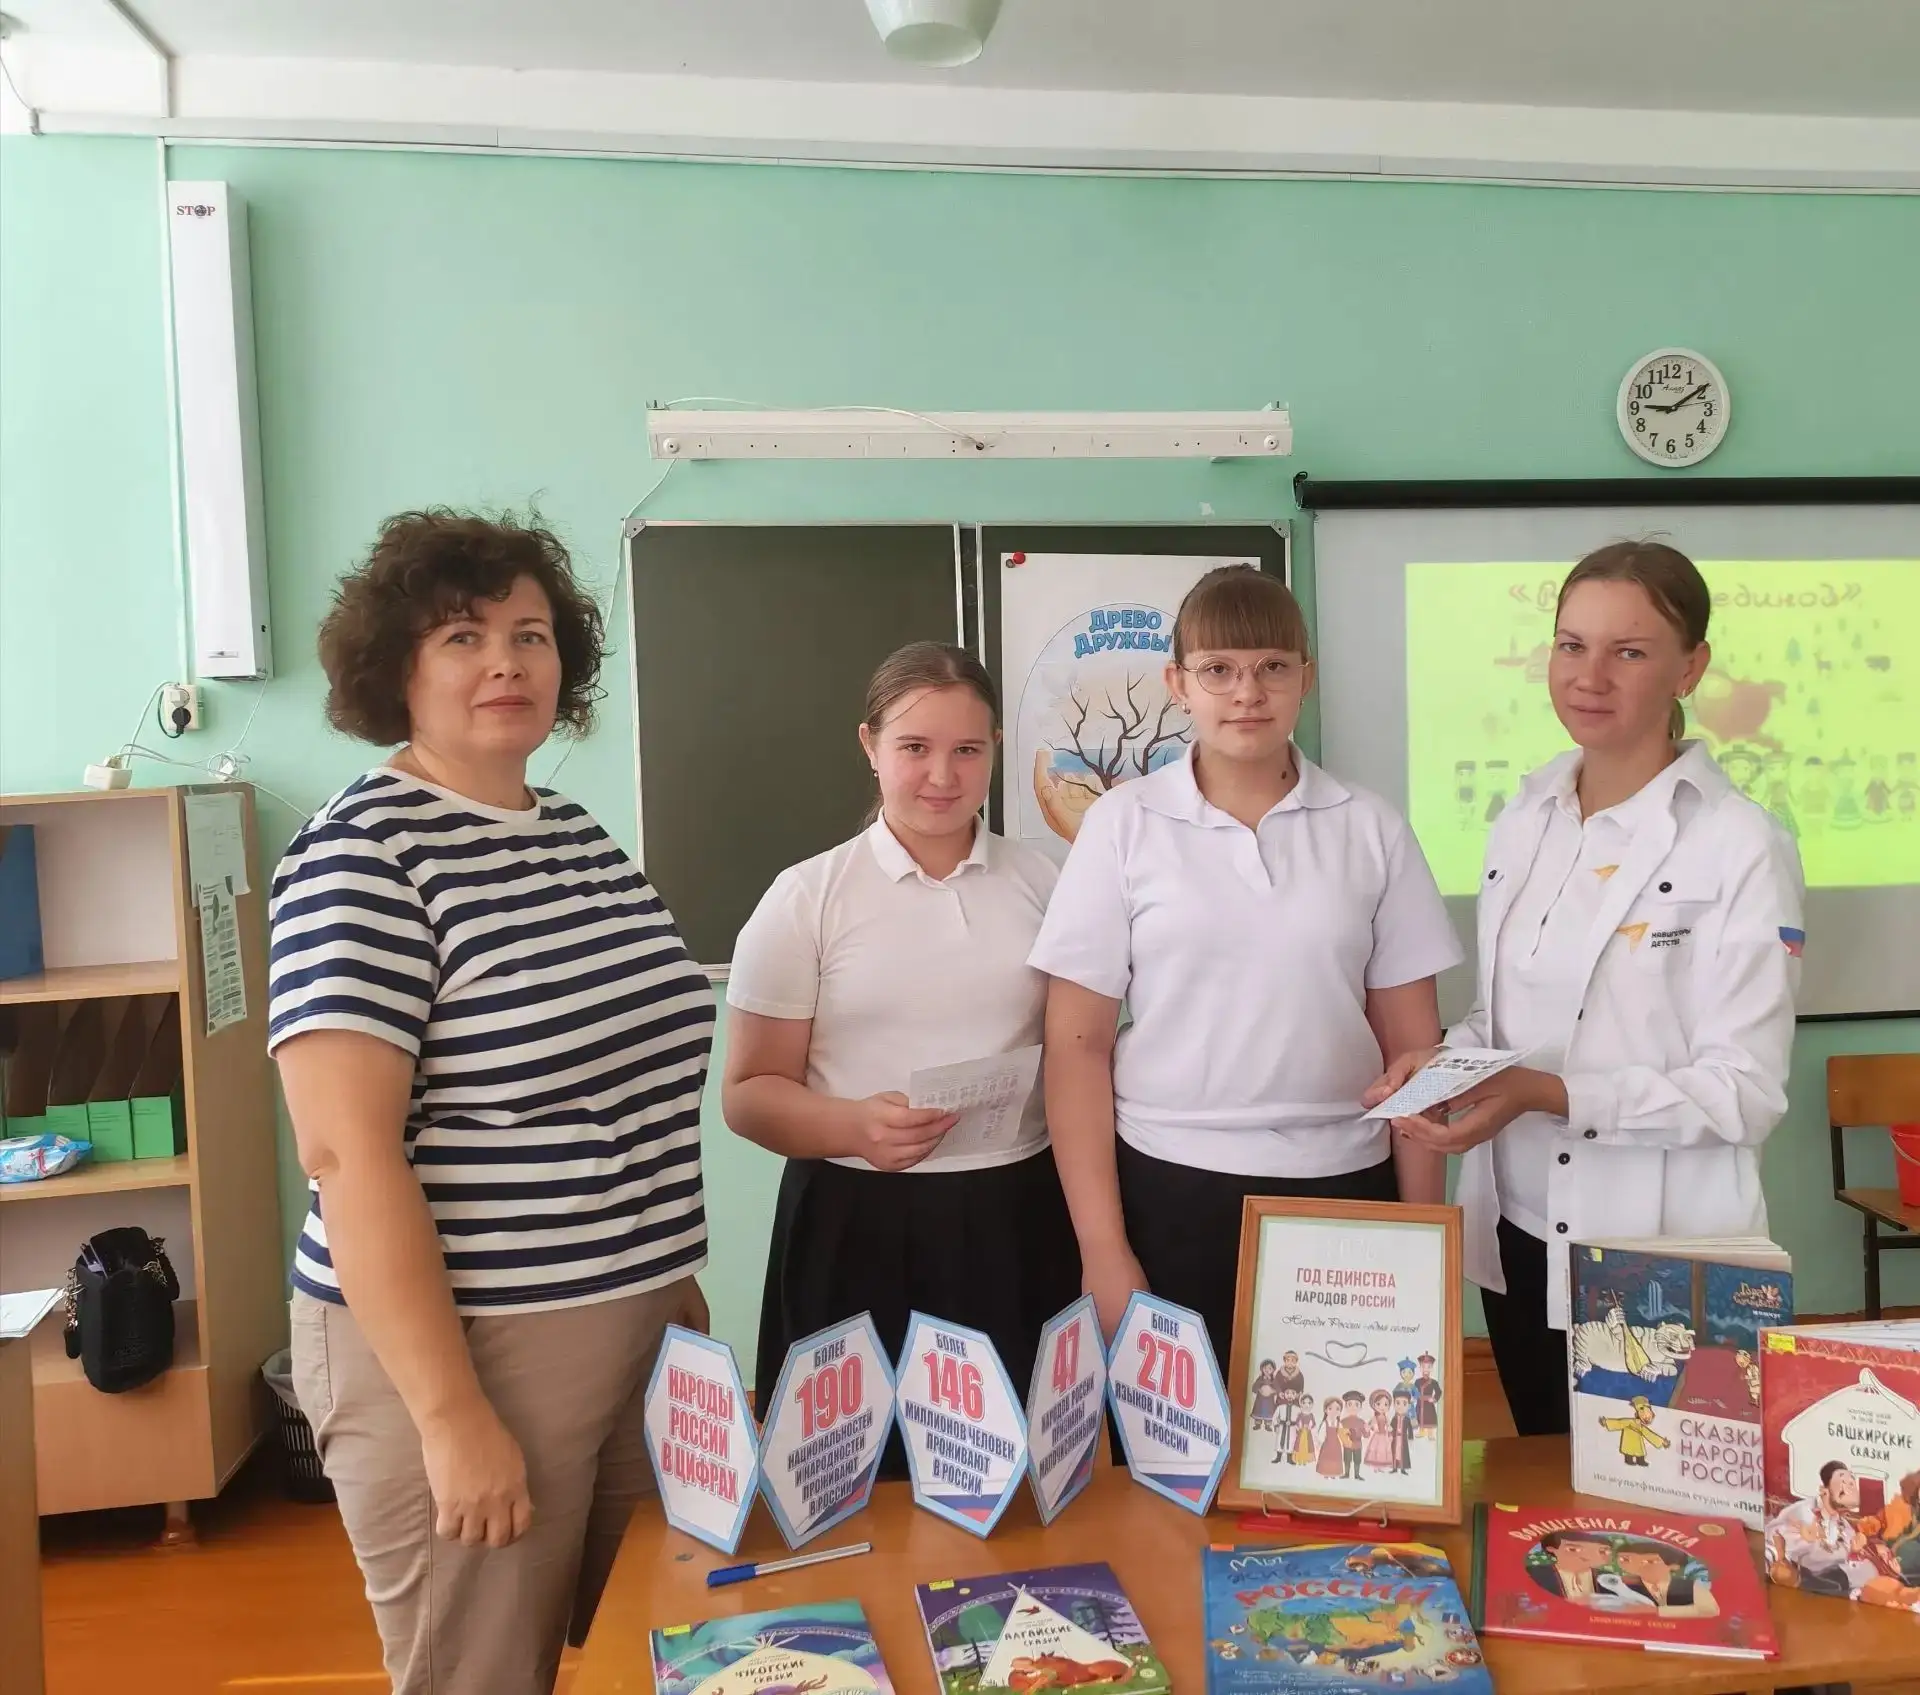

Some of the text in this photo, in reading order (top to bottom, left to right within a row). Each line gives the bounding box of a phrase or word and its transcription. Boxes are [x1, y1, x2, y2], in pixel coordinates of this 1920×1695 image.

[177, 205, 216, 217] STOP
[1648, 370, 1664, 385] 11
[1663, 364, 1681, 379] 12
[1686, 371, 1694, 385] 1
[1636, 384, 1652, 399] 10
[1630, 401, 1639, 415] 9
[1704, 403, 1713, 417] 3
[1636, 418, 1645, 432] 8
[1696, 419, 1706, 433] 4
[1649, 433, 1658, 447] 7
[1666, 439, 1675, 453] 6
[1685, 434, 1694, 447] 5
[1089, 609, 1163, 633] ДРЕВО
[1074, 630, 1172, 659] ДРУЖБЫ
[1296, 1267, 1396, 1289] ГОД ЕДИНСТВА
[1295, 1289, 1396, 1309] НАРОДОВ РОССИИ
[1151, 1312, 1179, 1338] БОЛЕЕ
[814, 1338, 846, 1369] БОЛЕЕ
[936, 1334, 967, 1357] БОЛЕЕ
[1053, 1317, 1081, 1396] 47
[1136, 1328, 1198, 1411] 270
[668, 1365, 735, 1424] НАРОДЫ
[795, 1353, 864, 1441] 190
[922, 1349, 985, 1421] 146
[1041, 1372, 1095, 1434] НАРОДОВ РОССИИ
[1114, 1381, 1221, 1447] ЯЗЫКОВ И ДИАЛЕКТОВ
[670, 1404, 730, 1461] РОССИИ
[787, 1408, 873, 1471] НАЦИОНАЛЬНОСТЕЙ
[905, 1401, 1015, 1461] МИЛЛИОНОВ ЧЕЛОВЕК
[1145, 1418, 1189, 1455] В РОССИИ
[1828, 1421, 1912, 1449] БАШКИРСКИЕ
[795, 1433, 866, 1488] И НАРОДНОСТЕЙ
[926, 1432, 990, 1475] ПРОЖИВАЮТ
[1851, 1445, 1890, 1461] СКАЗКИ
[661, 1439, 739, 1504] В ЦИФРАХ
[802, 1457, 859, 1503] ПРОЖИВАЮТ
[933, 1459, 982, 1495] В РОССИИ
[810, 1480, 853, 1516] В РОССИИ
[1508, 1517, 1700, 1549] ВОЛШЕБНАЯ УТКА
[1024, 1636, 1061, 1647] СКАЗКИ
[753, 1671, 793, 1684] СКАЗКИ
